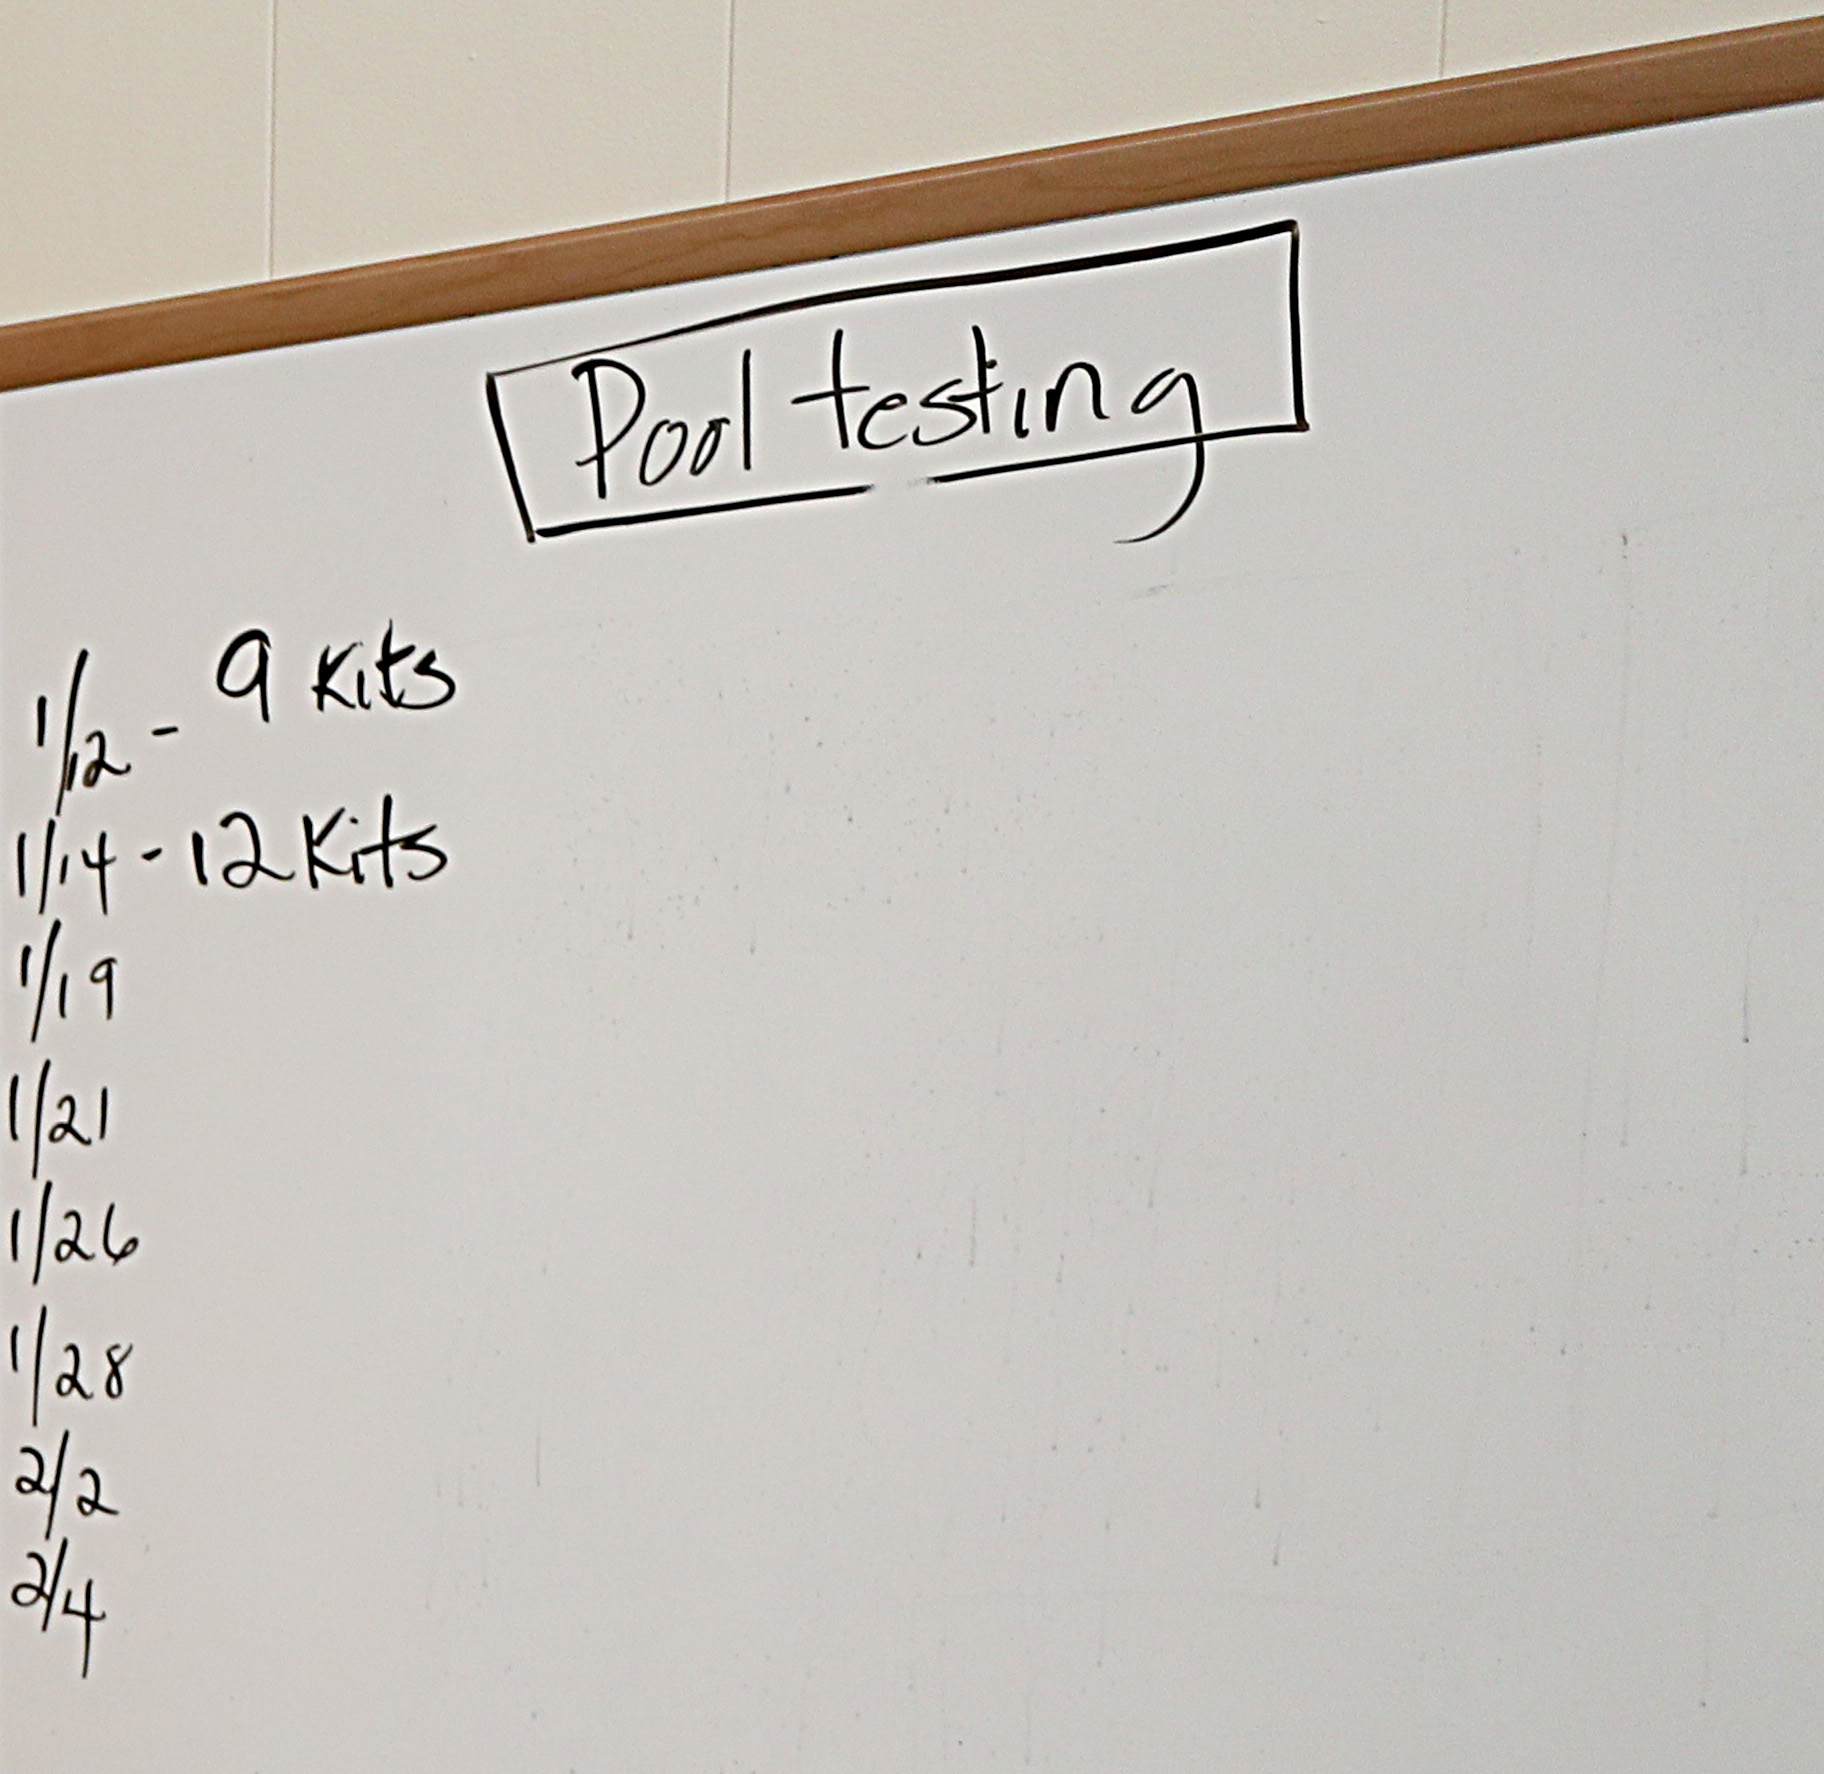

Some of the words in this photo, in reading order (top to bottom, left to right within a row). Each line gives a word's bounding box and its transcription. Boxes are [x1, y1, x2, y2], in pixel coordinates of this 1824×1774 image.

[569, 348, 754, 501] Pool
[789, 323, 1207, 545] testing
[215, 627, 273, 723] 9
[20, 918, 119, 1044] 1/19
[8, 1058, 109, 1181] 1/21
[10, 1179, 140, 1287] 1/26
[10, 1304, 134, 1428] 1/28
[14, 1429, 121, 1542] 2/2
[10, 1536, 109, 1680] 2/4
